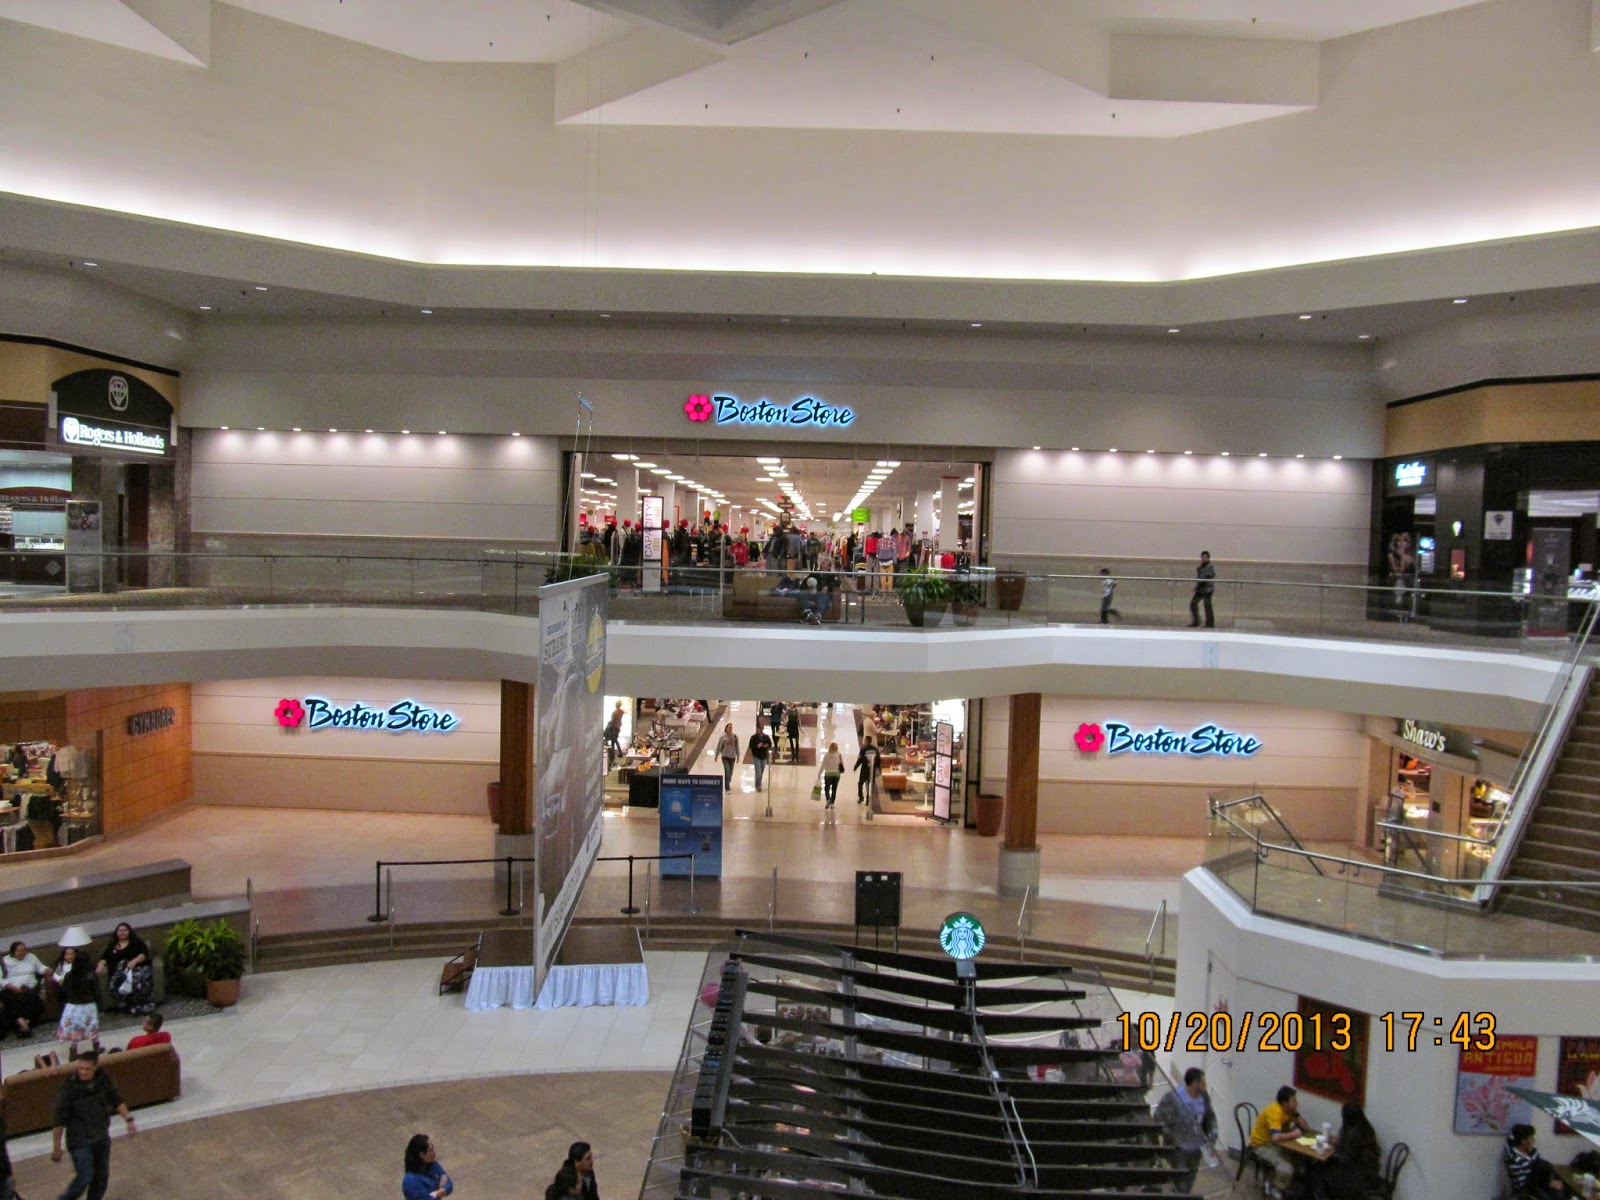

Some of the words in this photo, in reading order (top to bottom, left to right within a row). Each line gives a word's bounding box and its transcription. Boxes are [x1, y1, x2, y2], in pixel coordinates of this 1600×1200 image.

[713, 396, 790, 423] Boston
[790, 397, 856, 424] Store
[79, 424, 114, 446] Rogers
[115, 430, 123, 443] &
[124, 430, 165, 449] Hollands
[40, 495, 66, 504] Hollan
[644, 504, 654, 558] CAPACITY
[304, 699, 387, 728] Boston
[387, 700, 459, 730] Store
[1106, 723, 1189, 753] Boston
[1189, 725, 1263, 754] Store
[1403, 719, 1446, 752] Shaw's
[936, 731, 946, 783] CAPACITY
[699, 778, 721, 786] CONNECT
[1463, 1050, 1534, 1066] ANTIGUA
